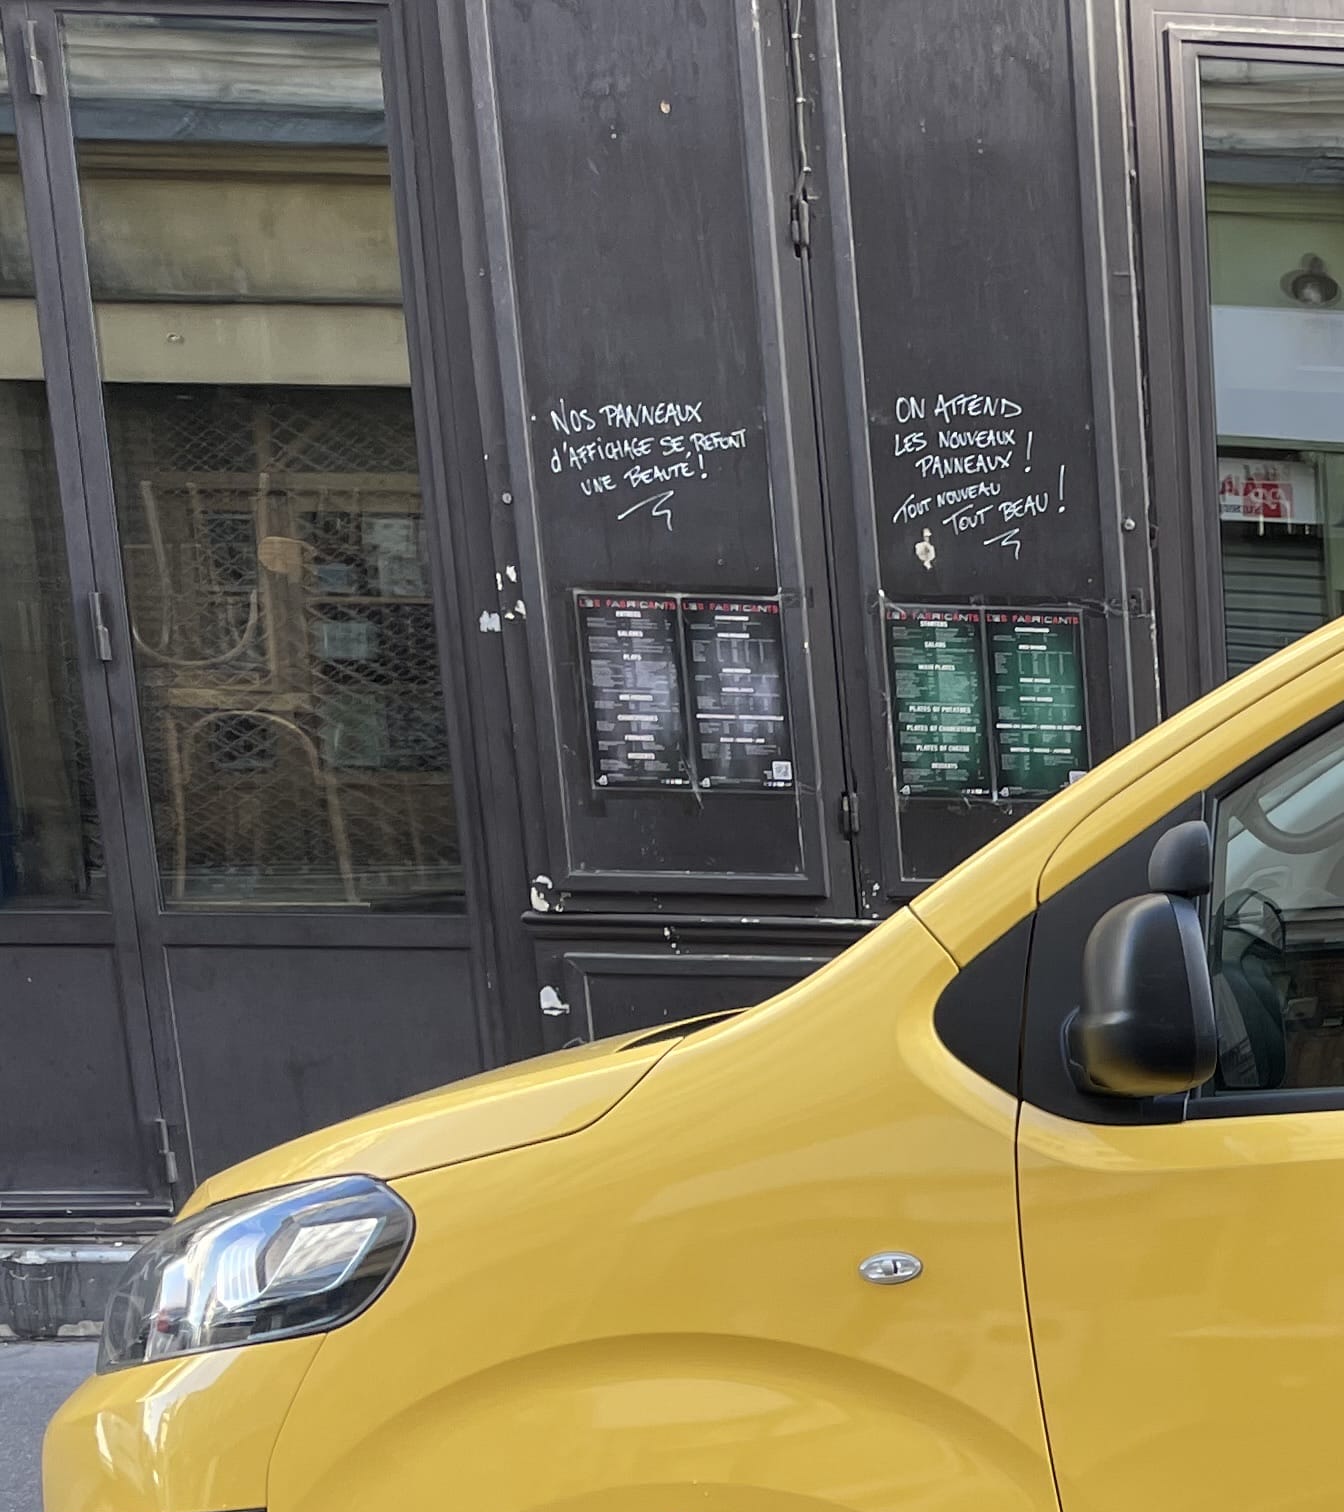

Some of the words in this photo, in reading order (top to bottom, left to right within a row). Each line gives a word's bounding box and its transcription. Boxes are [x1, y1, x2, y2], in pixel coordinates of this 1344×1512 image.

[551, 398, 596, 434] NOS
[599, 401, 702, 428] PANNEAUX
[896, 396, 926, 423] ON
[934, 394, 1022, 423] ATTEND
[660, 436, 685, 456] SE
[690, 428, 747, 452] REFONT
[894, 432, 927, 456] LES
[938, 429, 1016, 449] NOUVEAUX
[581, 475, 616, 495] UNE
[893, 494, 932, 523] TOUT
[937, 481, 1001, 507] NOUVEAU
[942, 503, 994, 535] TOUT
